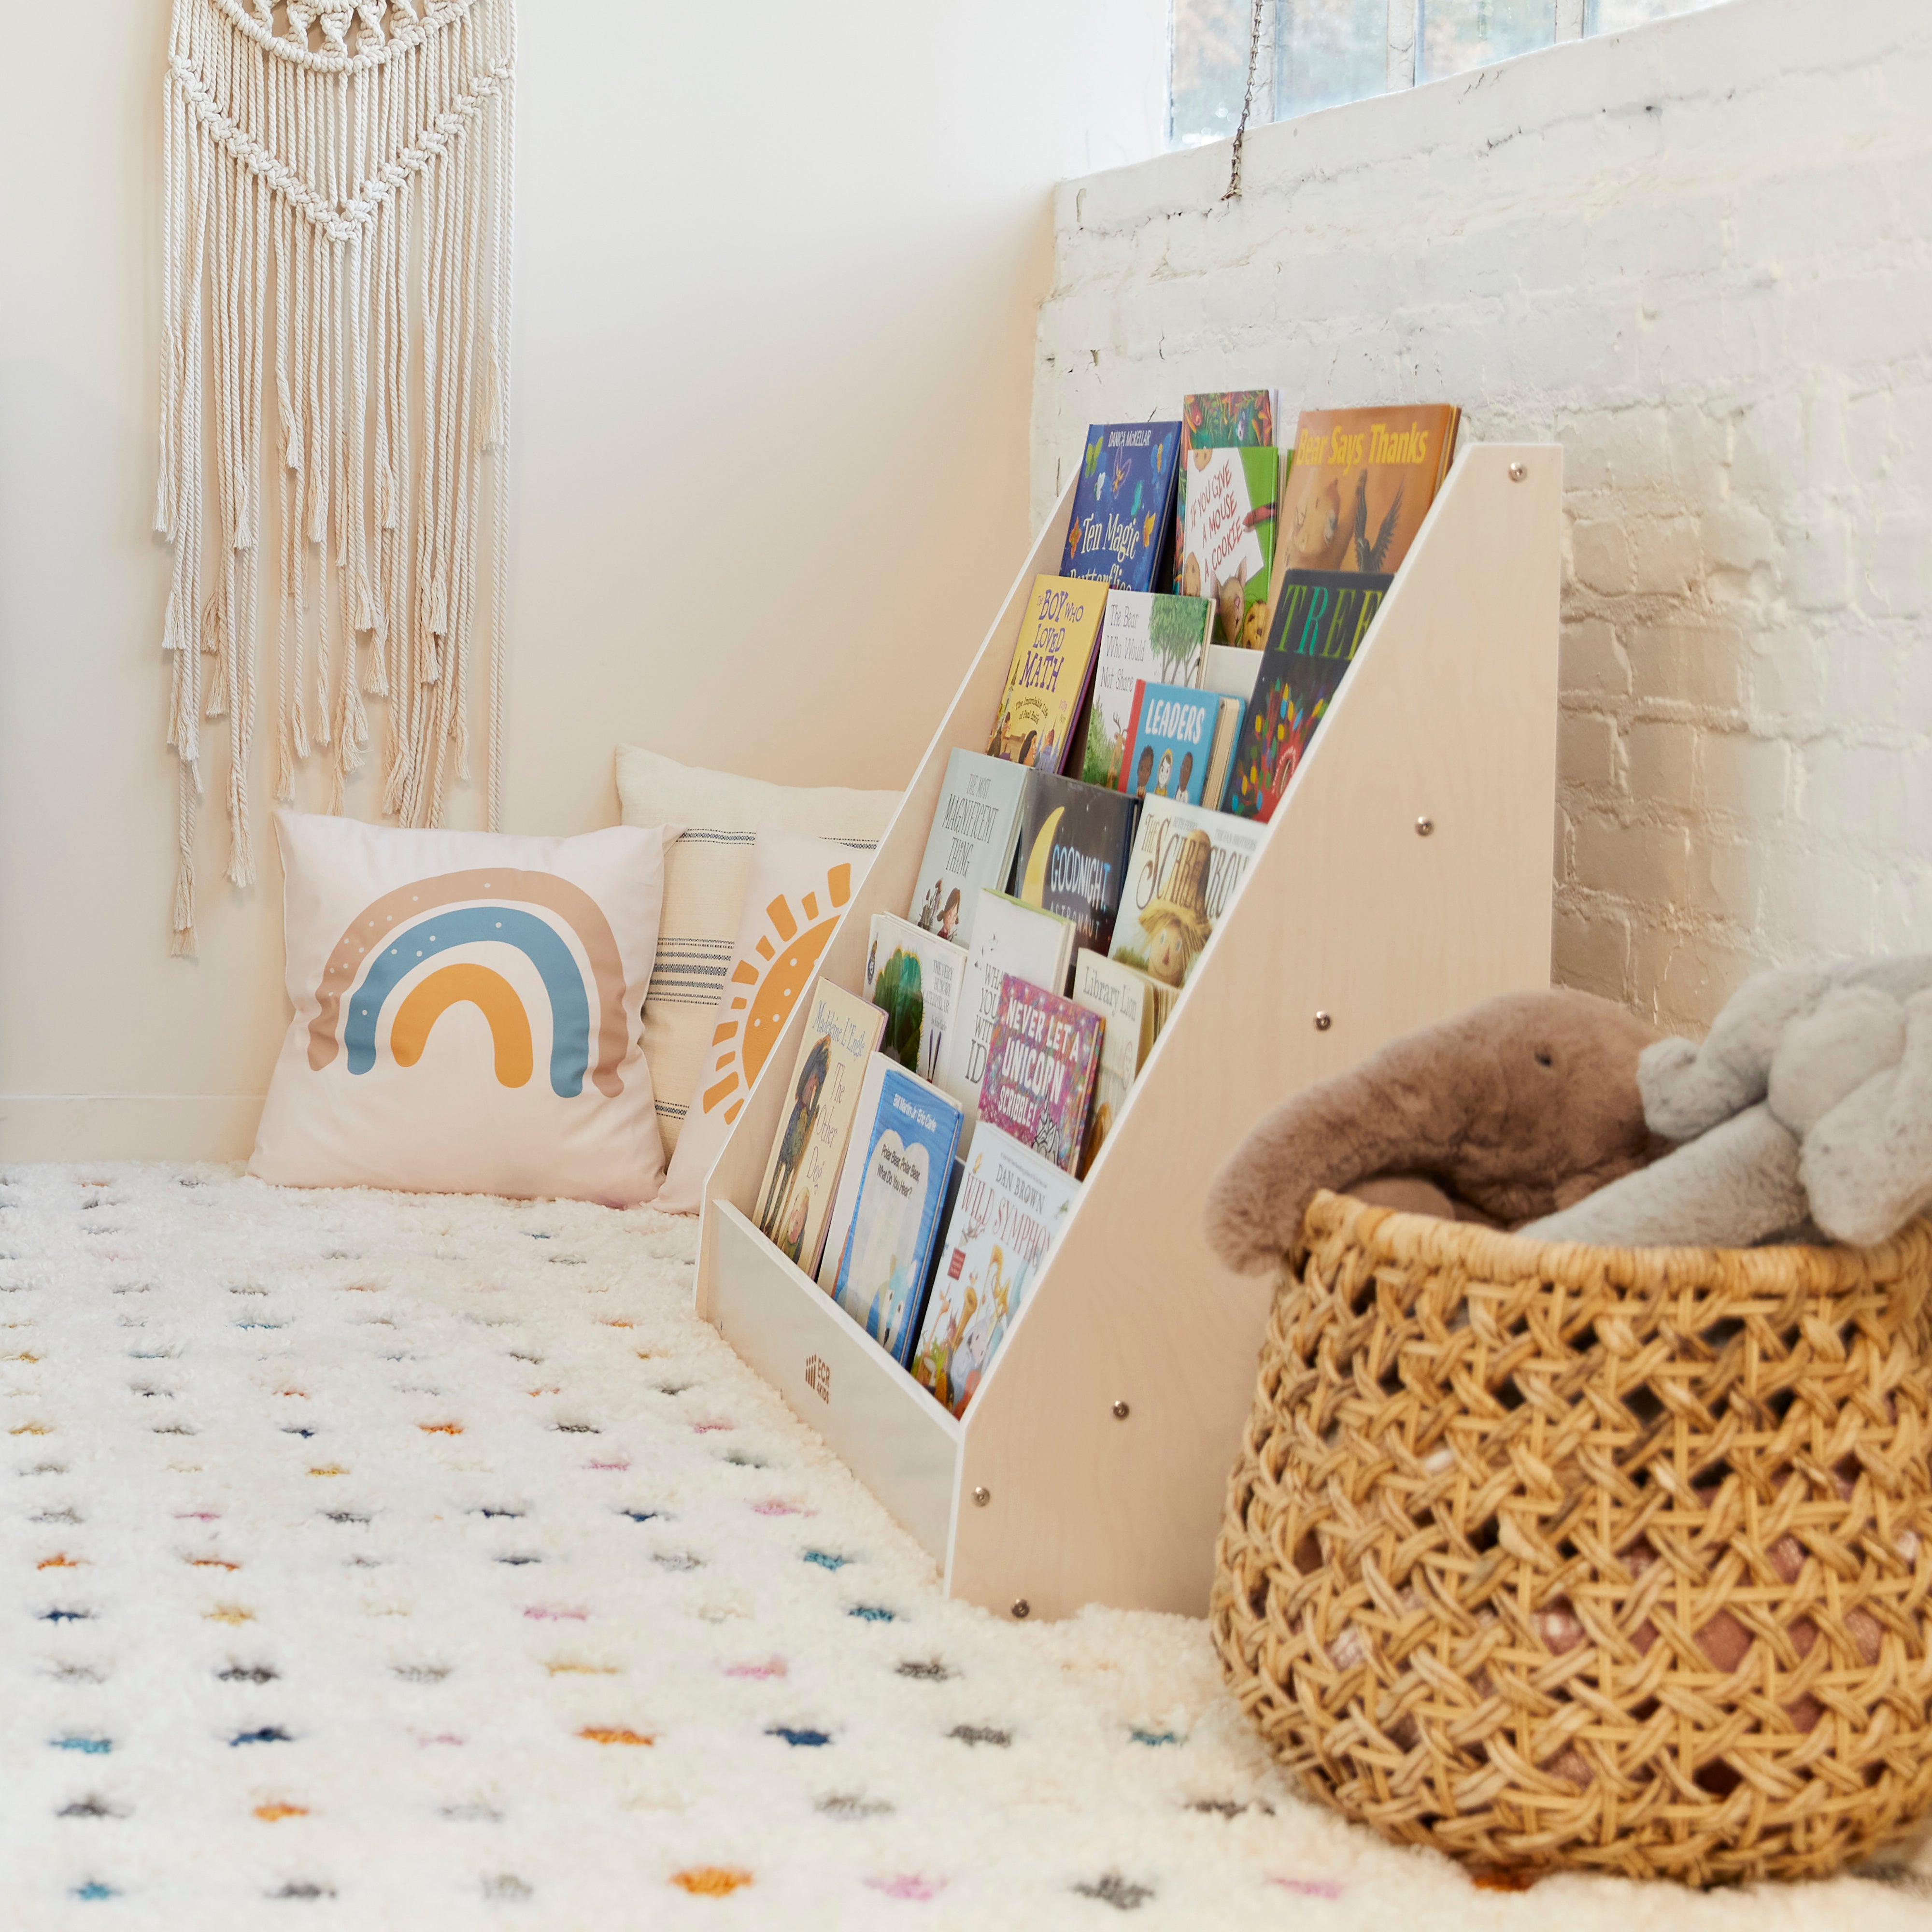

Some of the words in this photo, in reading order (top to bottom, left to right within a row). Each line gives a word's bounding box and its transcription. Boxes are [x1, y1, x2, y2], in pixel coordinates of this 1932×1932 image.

[1296, 428, 1328, 466] Bear
[1328, 426, 1364, 476] Says
[1368, 421, 1429, 464] Thanks
[1190, 498, 1197, 532] IF
[1197, 480, 1211, 517] YOU
[1211, 459, 1232, 500] GIVE
[1080, 512, 1103, 554] Ten
[1102, 513, 1140, 563] Magic
[1202, 523, 1207, 549] A
[1208, 490, 1237, 540] MOUSE
[1204, 557, 1209, 583] A
[1211, 515, 1243, 571] COOKIE
[1038, 589, 1069, 623] BOY
[1064, 602, 1084, 623] WHO
[1110, 604, 1122, 627] The
[1122, 605, 1139, 628] Bear
[1032, 623, 1065, 653] LOVED
[1106, 635, 1122, 659] Who
[1124, 637, 1147, 662] Would
[1018, 650, 1065, 693] MATH
[1100, 666, 1114, 689] Not
[1116, 668, 1134, 693] Share
[1145, 698, 1205, 745] LEADERS
[966, 774, 979, 796] THE
[976, 776, 992, 800] MOST
[942, 794, 999, 844] MAGNIFICENT
[1141, 813, 1160, 853] THE
[933, 959, 942, 976] THE
[941, 963, 954, 981] VERY
[934, 976, 952, 997] HUNGRY
[979, 987, 996, 1020] YOU
[1082, 966, 1120, 1017] Library
[1120, 984, 1137, 1022] Lion
[812, 1000, 842, 1042] Madeleine
[974, 1014, 994, 1043] WIT
[1006, 996, 1045, 1043] NEVER
[1046, 1015, 1072, 1054] LET
[1069, 1031, 1080, 1063] A
[830, 1062, 845, 1104] The
[1002, 1037, 1065, 1105] UNICORN
[816, 1104, 838, 1148] Other
[998, 1084, 1037, 1133] SCRIBBLE!
[806, 1146, 825, 1196] Dog
[881, 1144, 892, 1162] Polar
[900, 1157, 911, 1175] Polar
[877, 1163, 888, 1182] What
[886, 1170, 893, 1185] Do
[899, 1179, 912, 1200] Hear?
[996, 1163, 1014, 1192] DAN
[1014, 1176, 1046, 1215] BROWN
[961, 1172, 995, 1227] WILD
[992, 1196, 1051, 1268] SYMPHO
